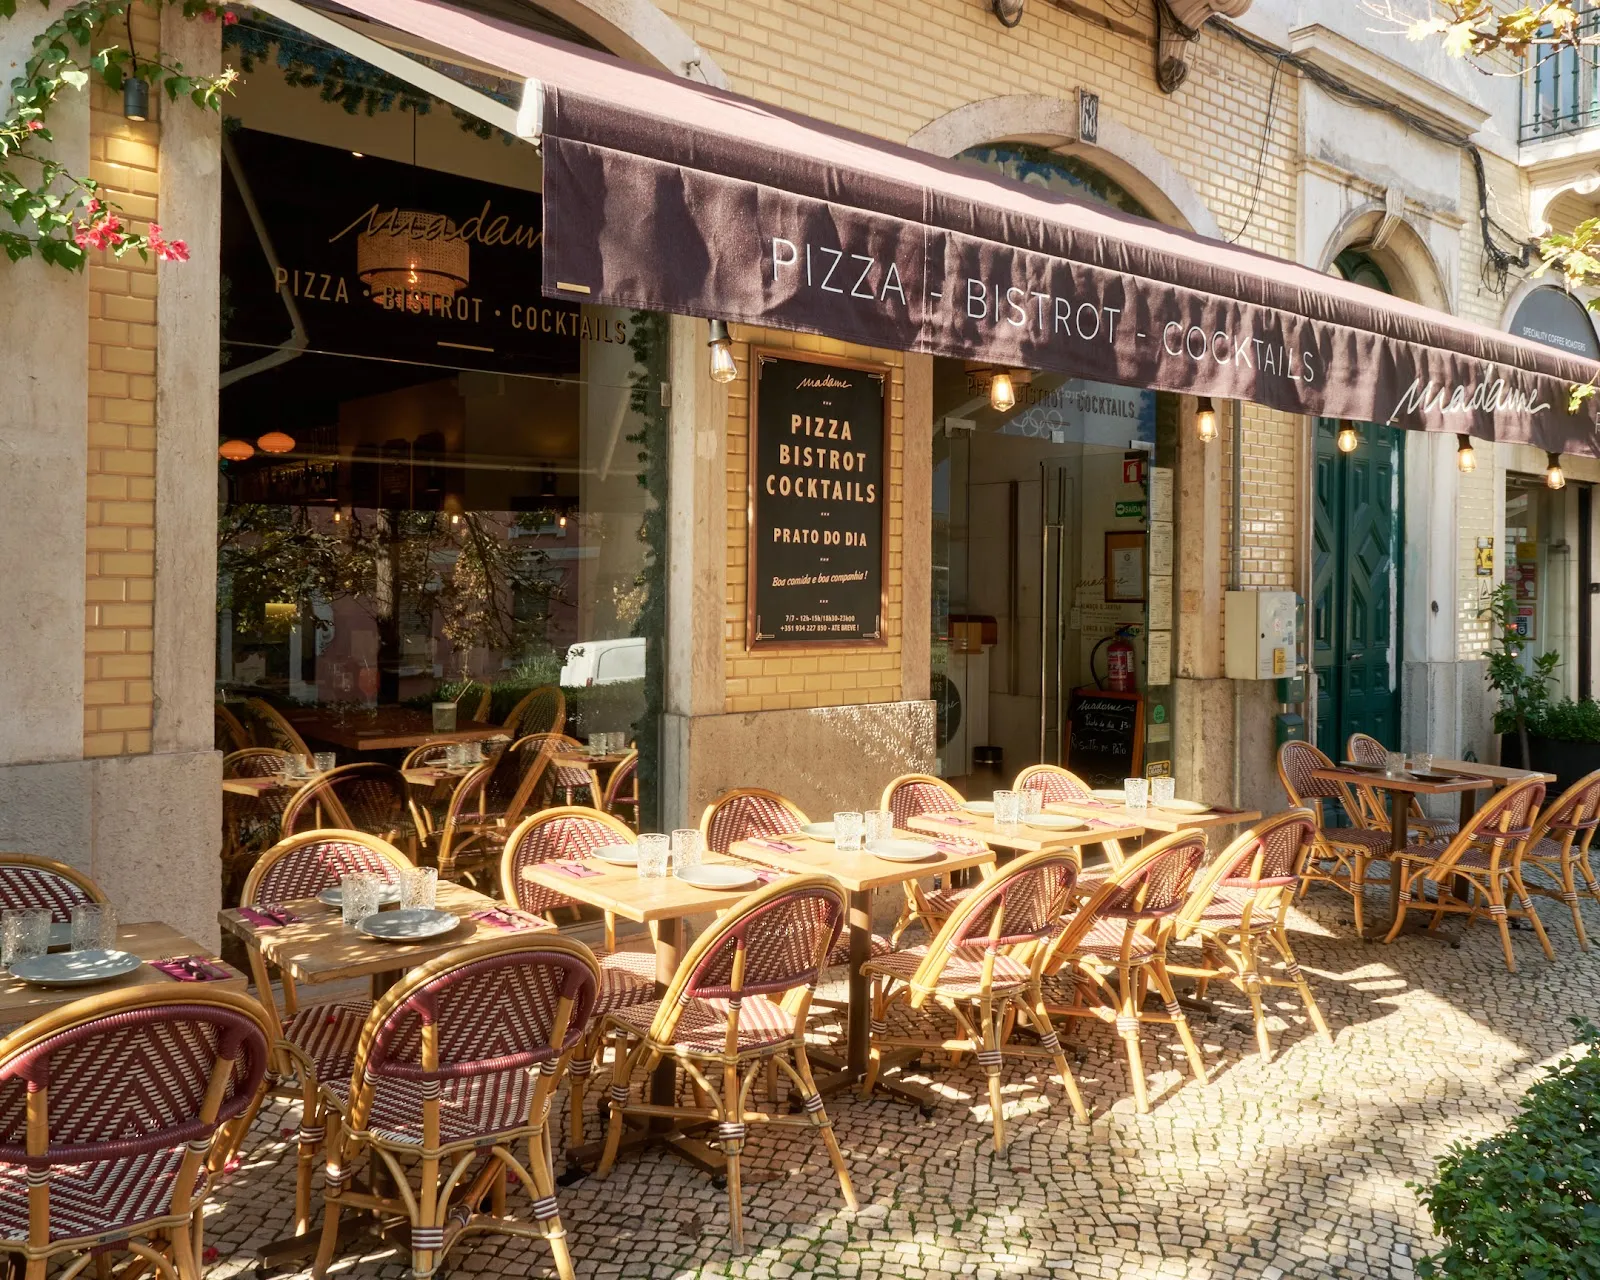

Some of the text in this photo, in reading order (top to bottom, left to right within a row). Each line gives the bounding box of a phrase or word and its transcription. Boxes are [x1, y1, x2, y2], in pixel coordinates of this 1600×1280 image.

[1082, 96, 1096, 137] 68
[329, 200, 543, 249] madam
[275, 267, 626, 344] PIZZA BISTROT COCKTAILS
[772, 237, 906, 305] PIZZA
[967, 278, 1121, 344] BISTROT
[1163, 321, 1315, 383] COCKTAILS
[1523, 326, 1586, 352] SPECIALITY COFFEE ROASTERS
[1076, 395, 1135, 418] COCKTAILS
[791, 413, 852, 441] PIZZA
[779, 444, 866, 472] BISTROT
[766, 474, 875, 503] COCKTAILS
[773, 527, 867, 547] PRATO DO DIA
[772, 576, 786, 587] Boa
[787, 574, 811, 585] comida
[812, 576, 817, 584] e
[818, 573, 829, 583] boa
